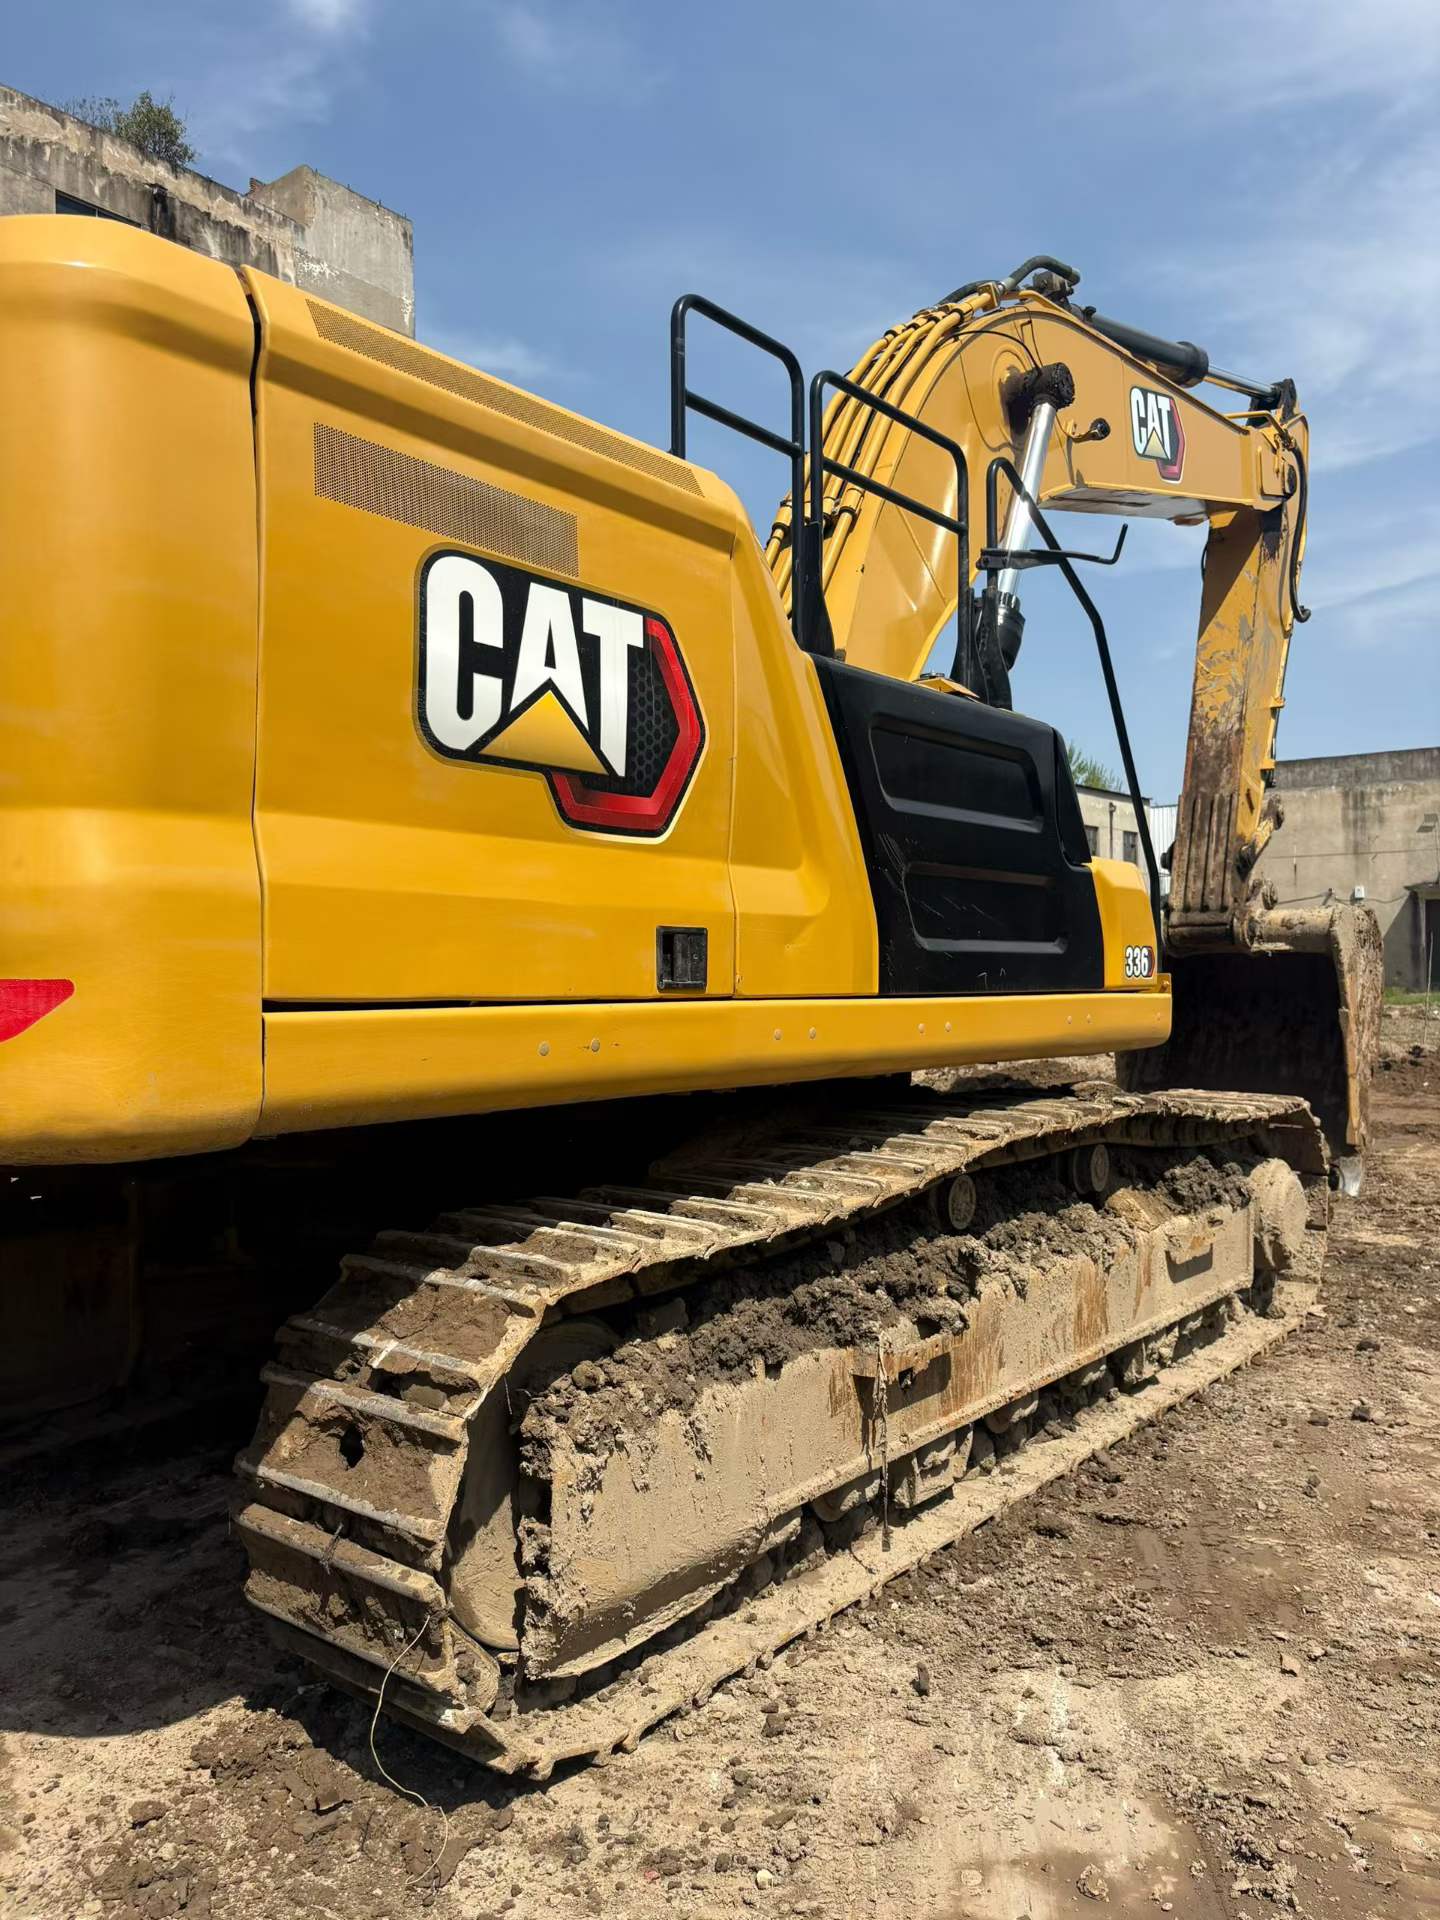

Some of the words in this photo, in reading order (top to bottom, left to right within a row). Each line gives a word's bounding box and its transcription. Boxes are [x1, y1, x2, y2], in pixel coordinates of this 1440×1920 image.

[1131, 388, 1171, 460] CAT
[426, 556, 643, 777] CAT
[1125, 946, 1149, 977] 336
